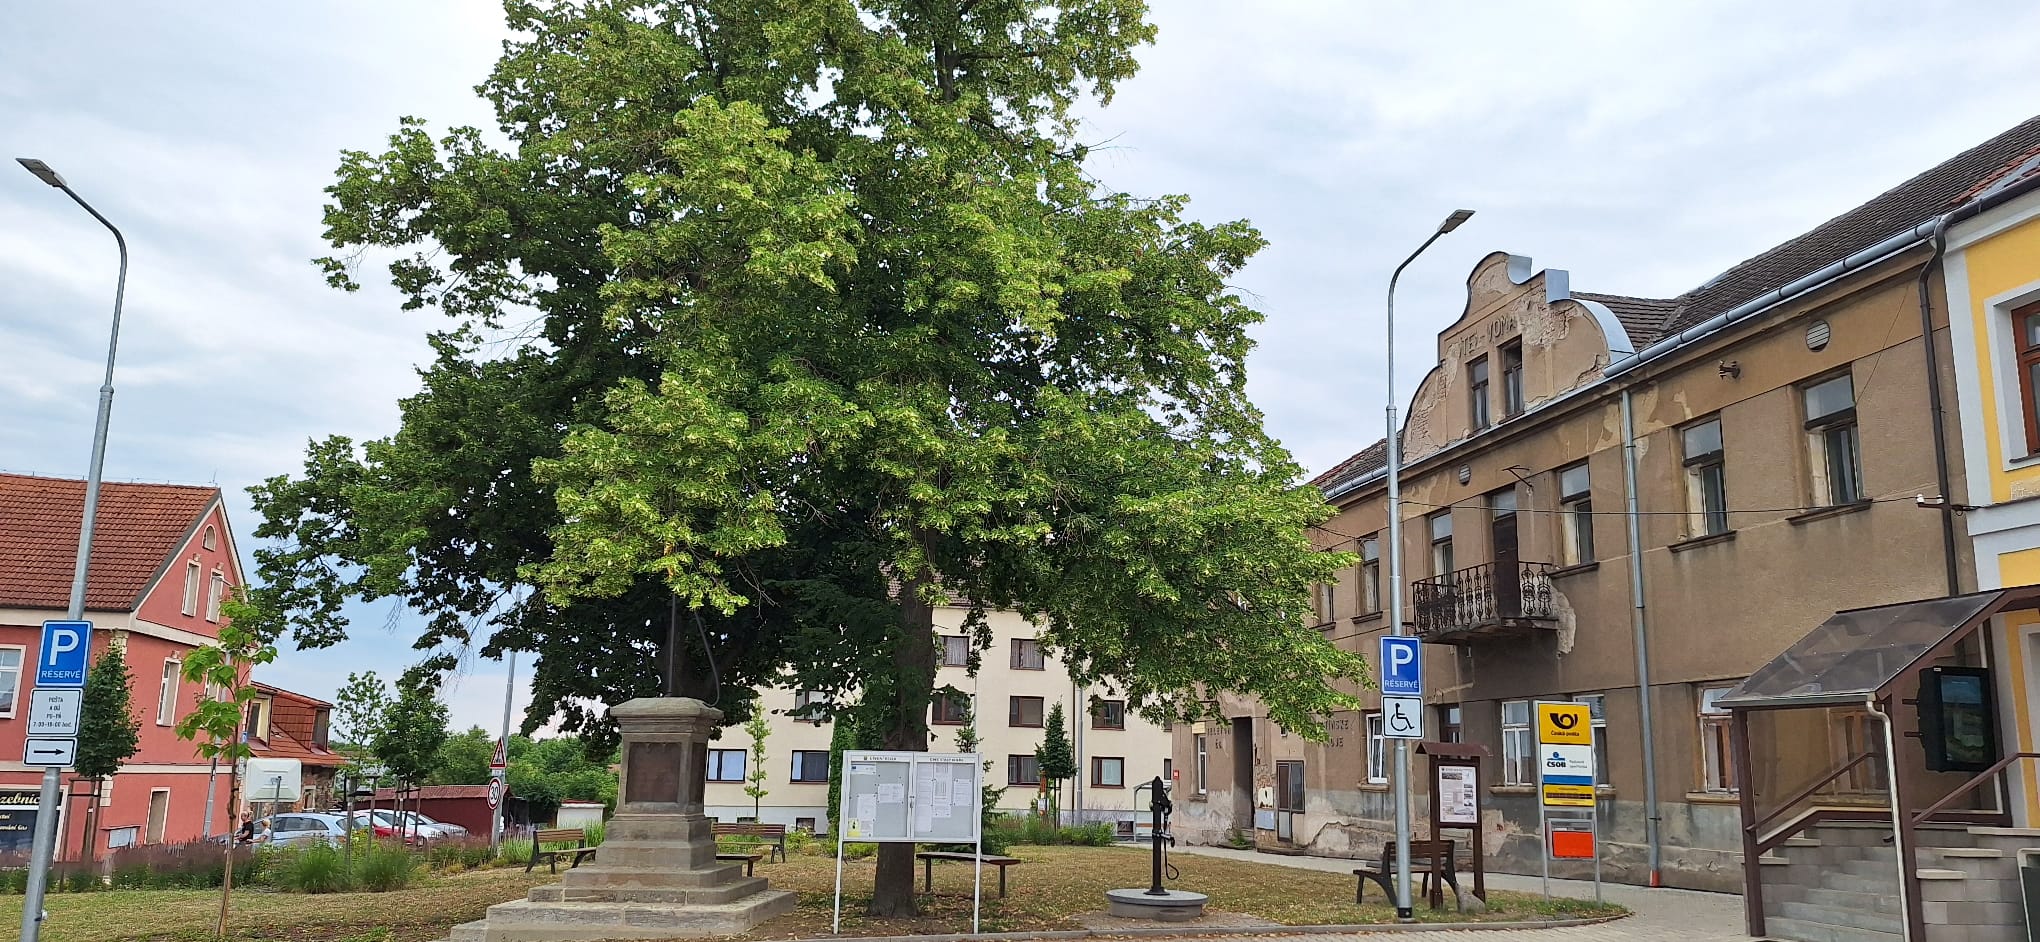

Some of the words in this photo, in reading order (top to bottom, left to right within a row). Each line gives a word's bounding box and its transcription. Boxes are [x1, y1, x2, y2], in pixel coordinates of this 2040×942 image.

[49, 629, 79, 666] P
[1391, 643, 1413, 676] P
[0, 792, 40, 804] zebnic
[490, 786, 499, 801] 30
